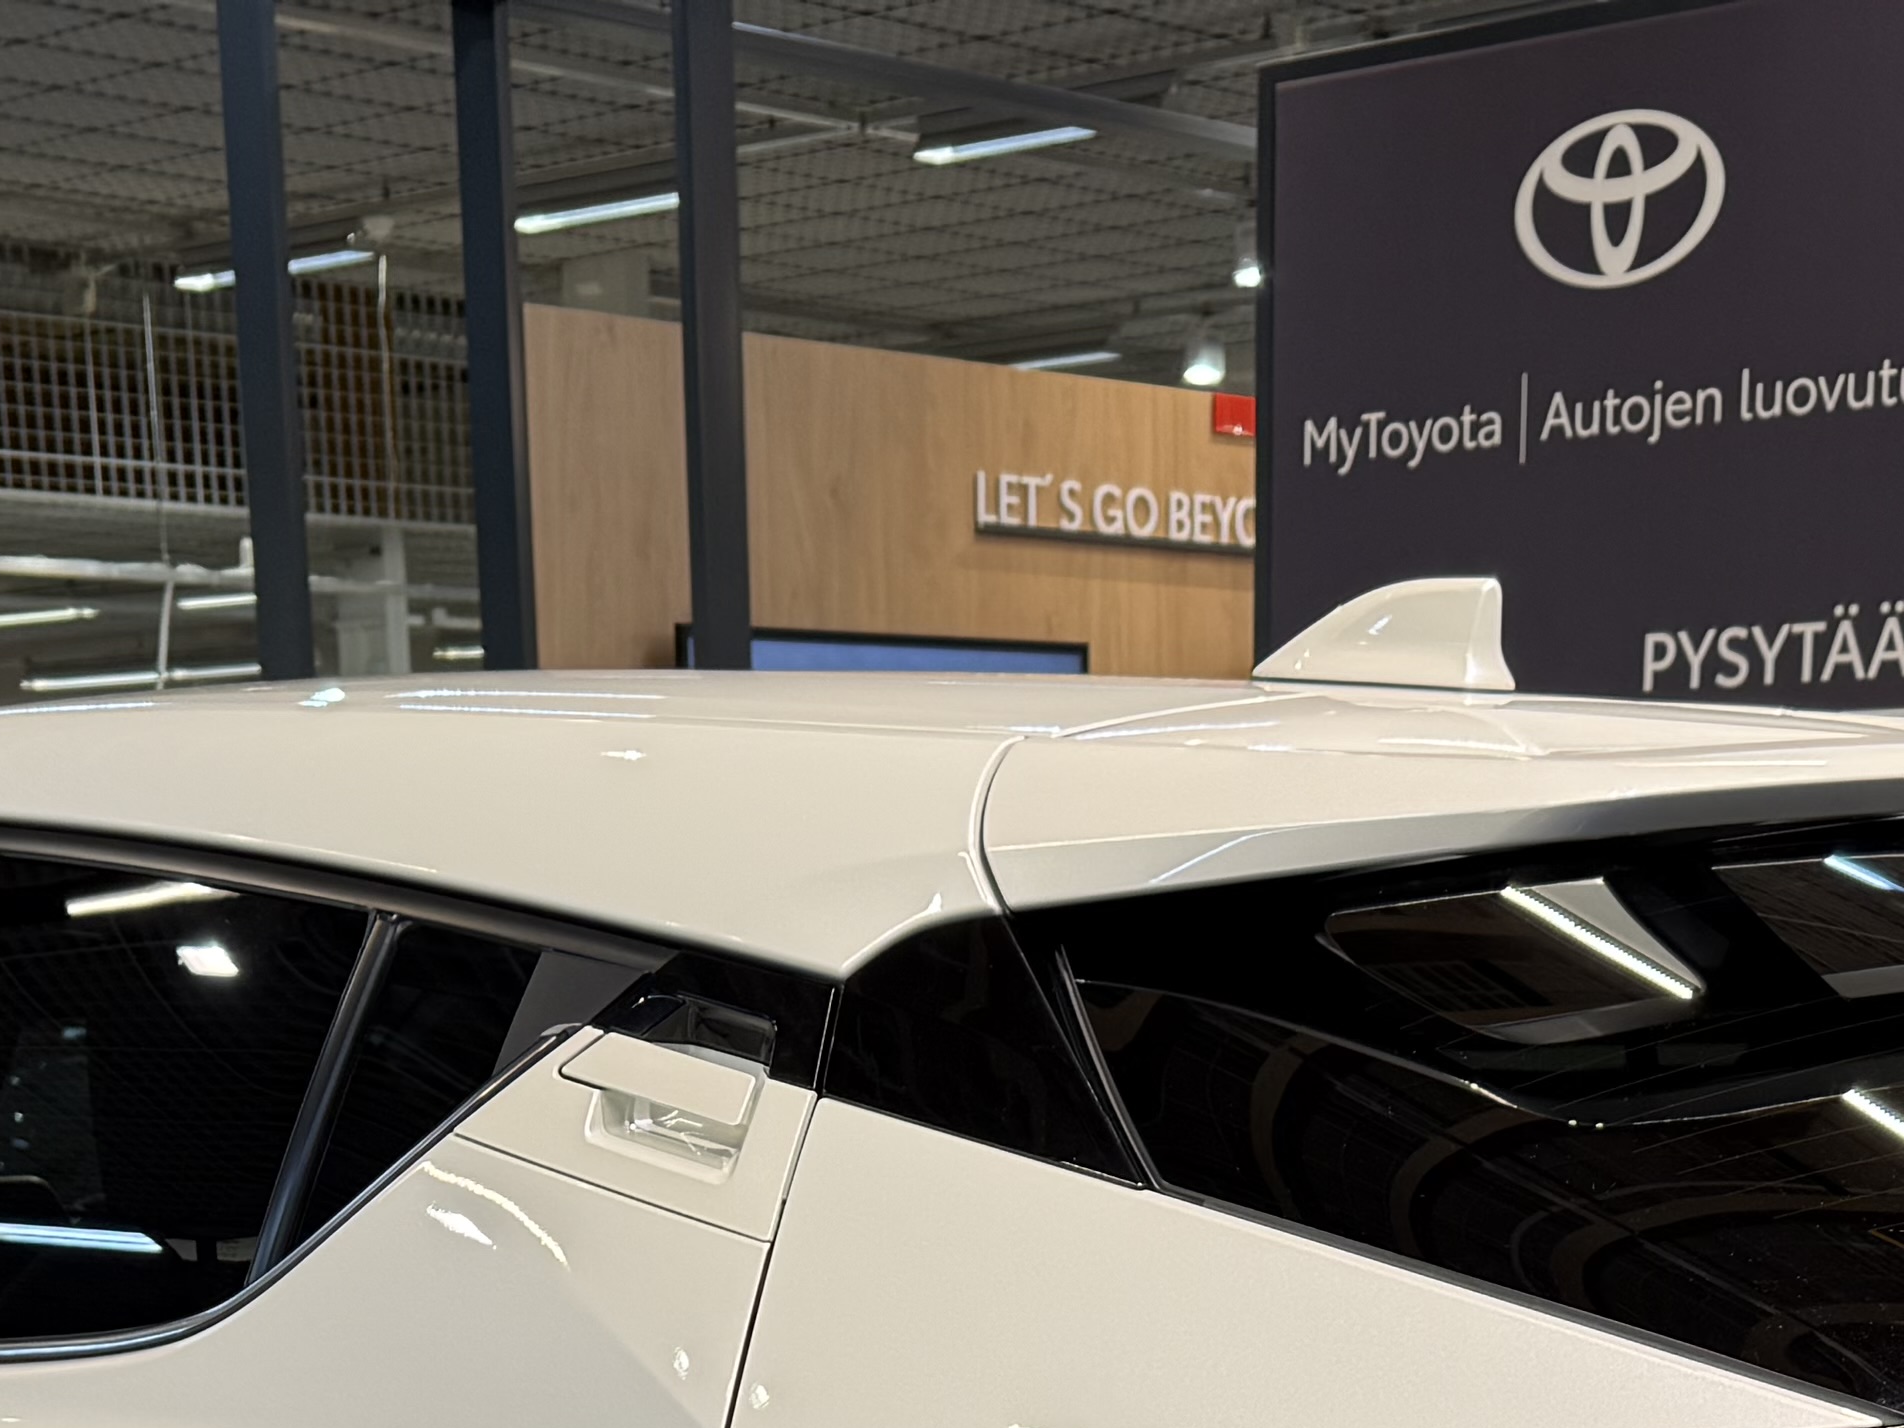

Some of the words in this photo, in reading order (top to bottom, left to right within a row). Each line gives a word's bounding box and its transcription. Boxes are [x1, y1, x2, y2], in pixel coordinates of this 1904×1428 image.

[1303, 405, 1502, 475] MyToyota
[1540, 380, 1722, 443] Autojen
[1093, 484, 1160, 539] GO
